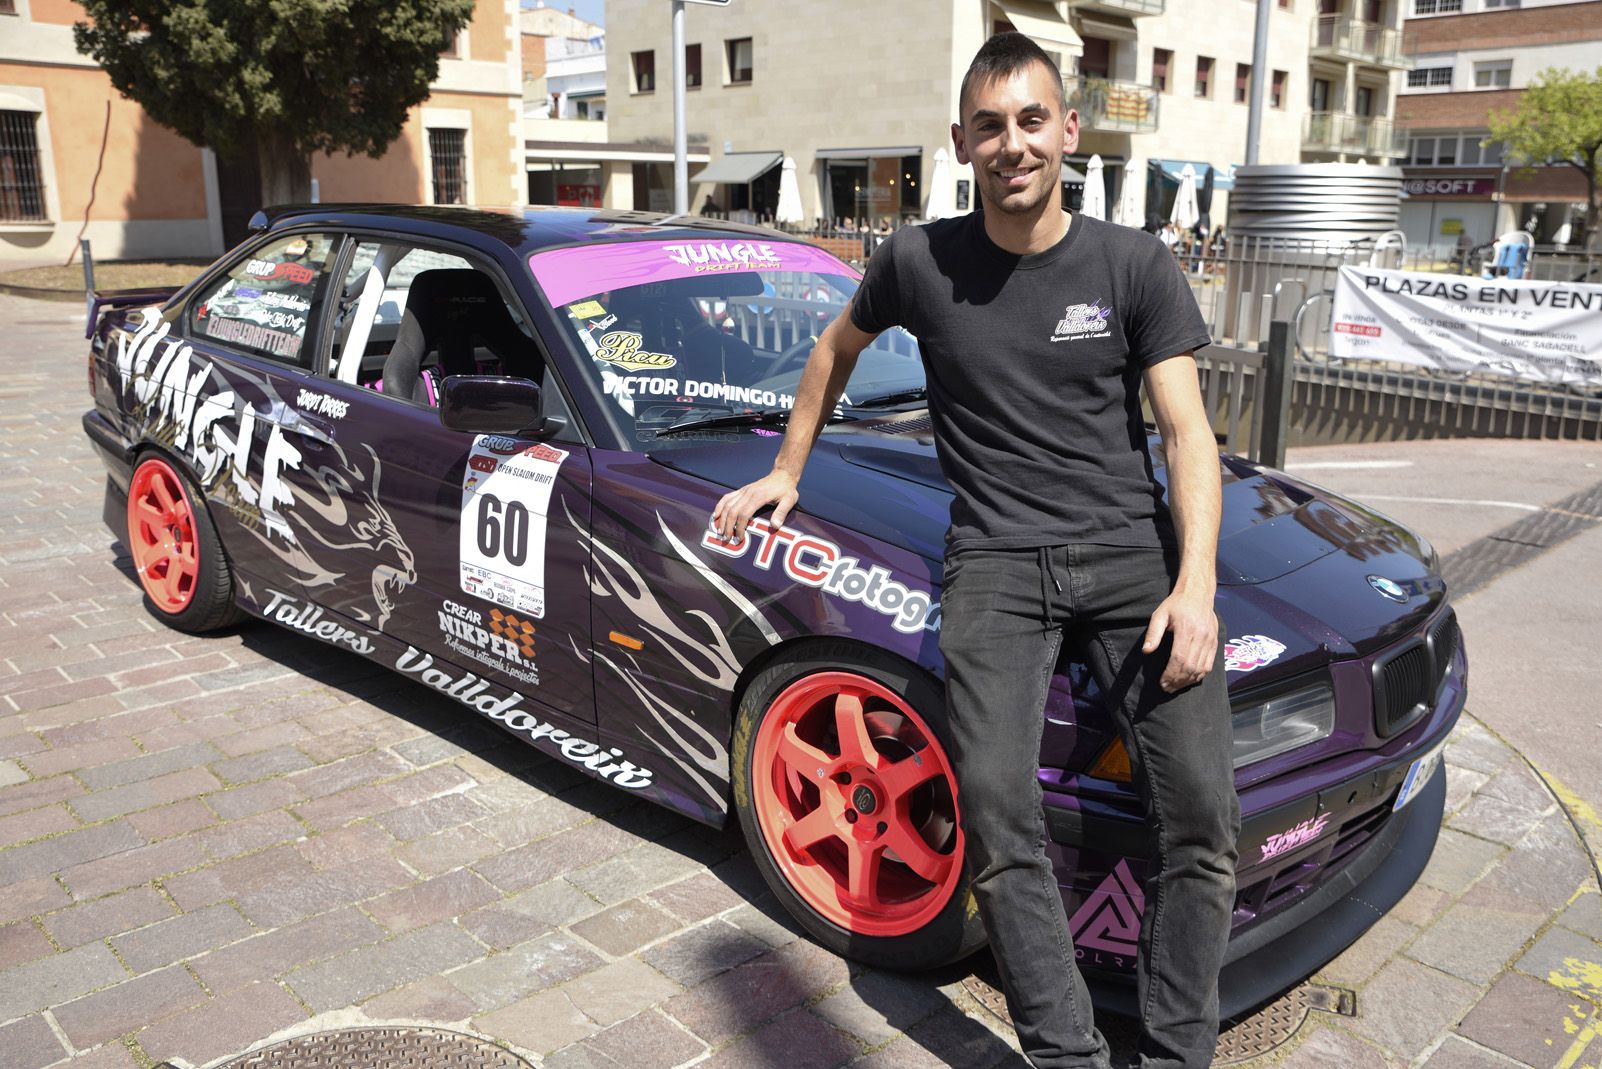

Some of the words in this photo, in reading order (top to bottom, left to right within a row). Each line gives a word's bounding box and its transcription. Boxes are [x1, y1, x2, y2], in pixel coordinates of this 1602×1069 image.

[662, 243, 781, 266] JUNGLE
[745, 262, 781, 270] TEAM
[246, 259, 276, 276] GRUP
[1365, 275, 1468, 302] PLAZAS
[1478, 287, 1518, 304] EN
[602, 375, 679, 396] VICTOR
[685, 380, 776, 407] DOMINGO
[319, 396, 350, 419] TORRES
[478, 434, 514, 451] GRUP
[498, 463, 512, 476] OPEN
[512, 467, 536, 481] SLALOM
[535, 473, 553, 486] DRIFT
[477, 493, 529, 567] 60
[478, 569, 492, 580] EBC
[443, 599, 482, 626] CREAR
[438, 611, 522, 666] NIKPER
[262, 588, 376, 655] Tallers
[395, 645, 653, 789] Valldoreix
